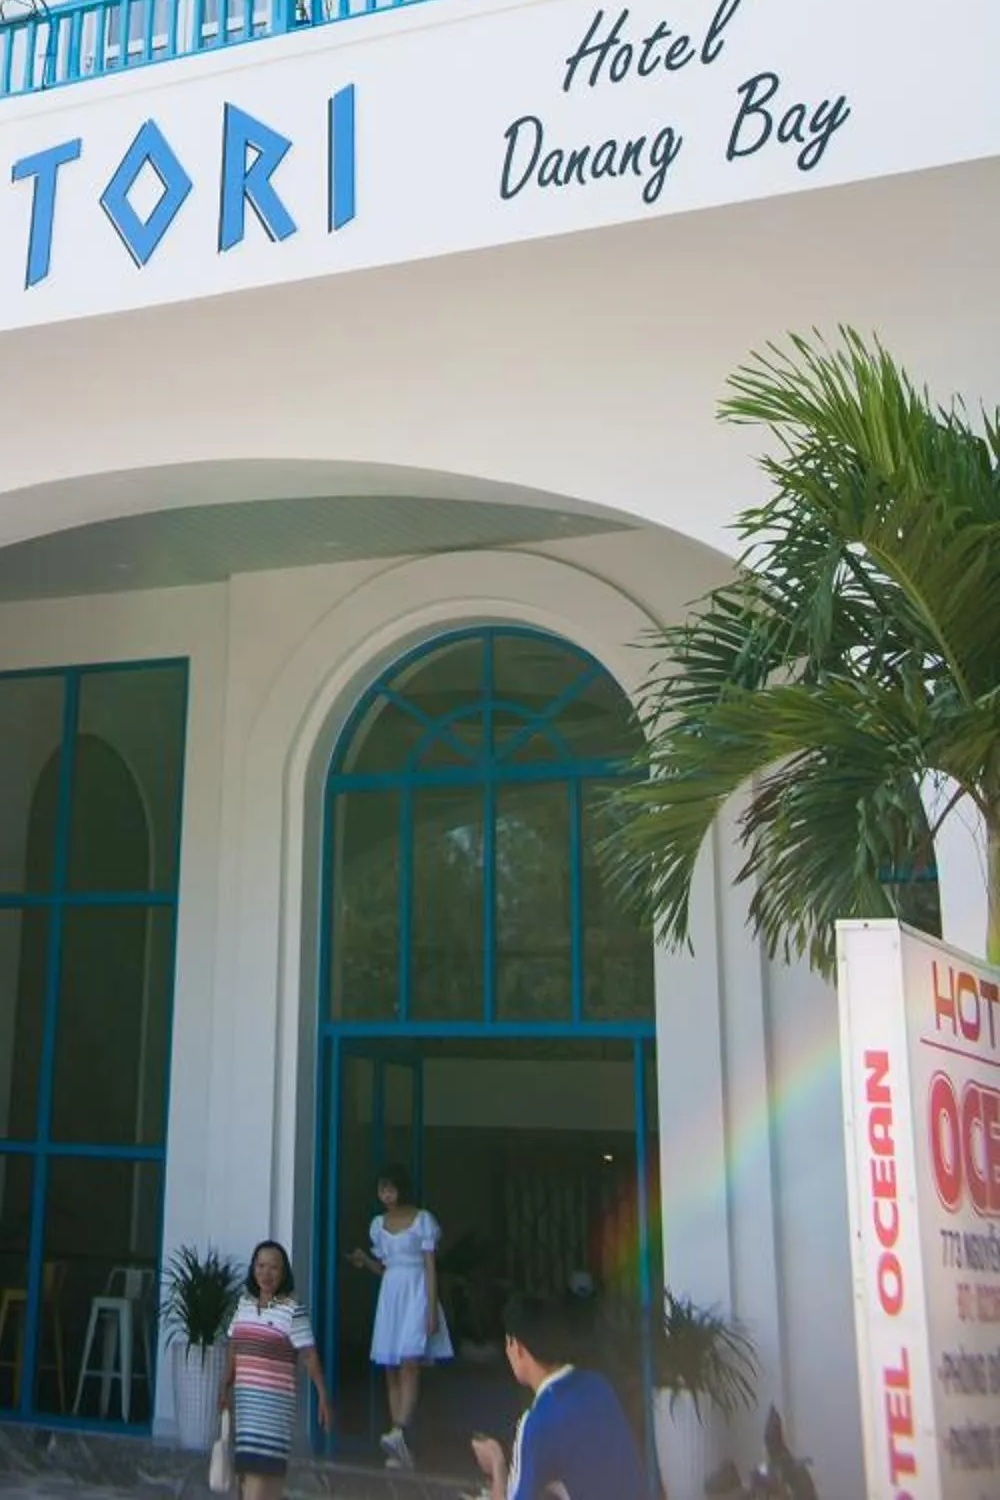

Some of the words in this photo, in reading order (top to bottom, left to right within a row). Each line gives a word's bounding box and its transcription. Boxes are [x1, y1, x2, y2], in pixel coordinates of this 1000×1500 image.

[500, 115, 683, 204] Danang
[726, 72, 851, 171] Bay
[864, 1051, 904, 1317] OCEAN
[884, 1347, 917, 1500] TEL
